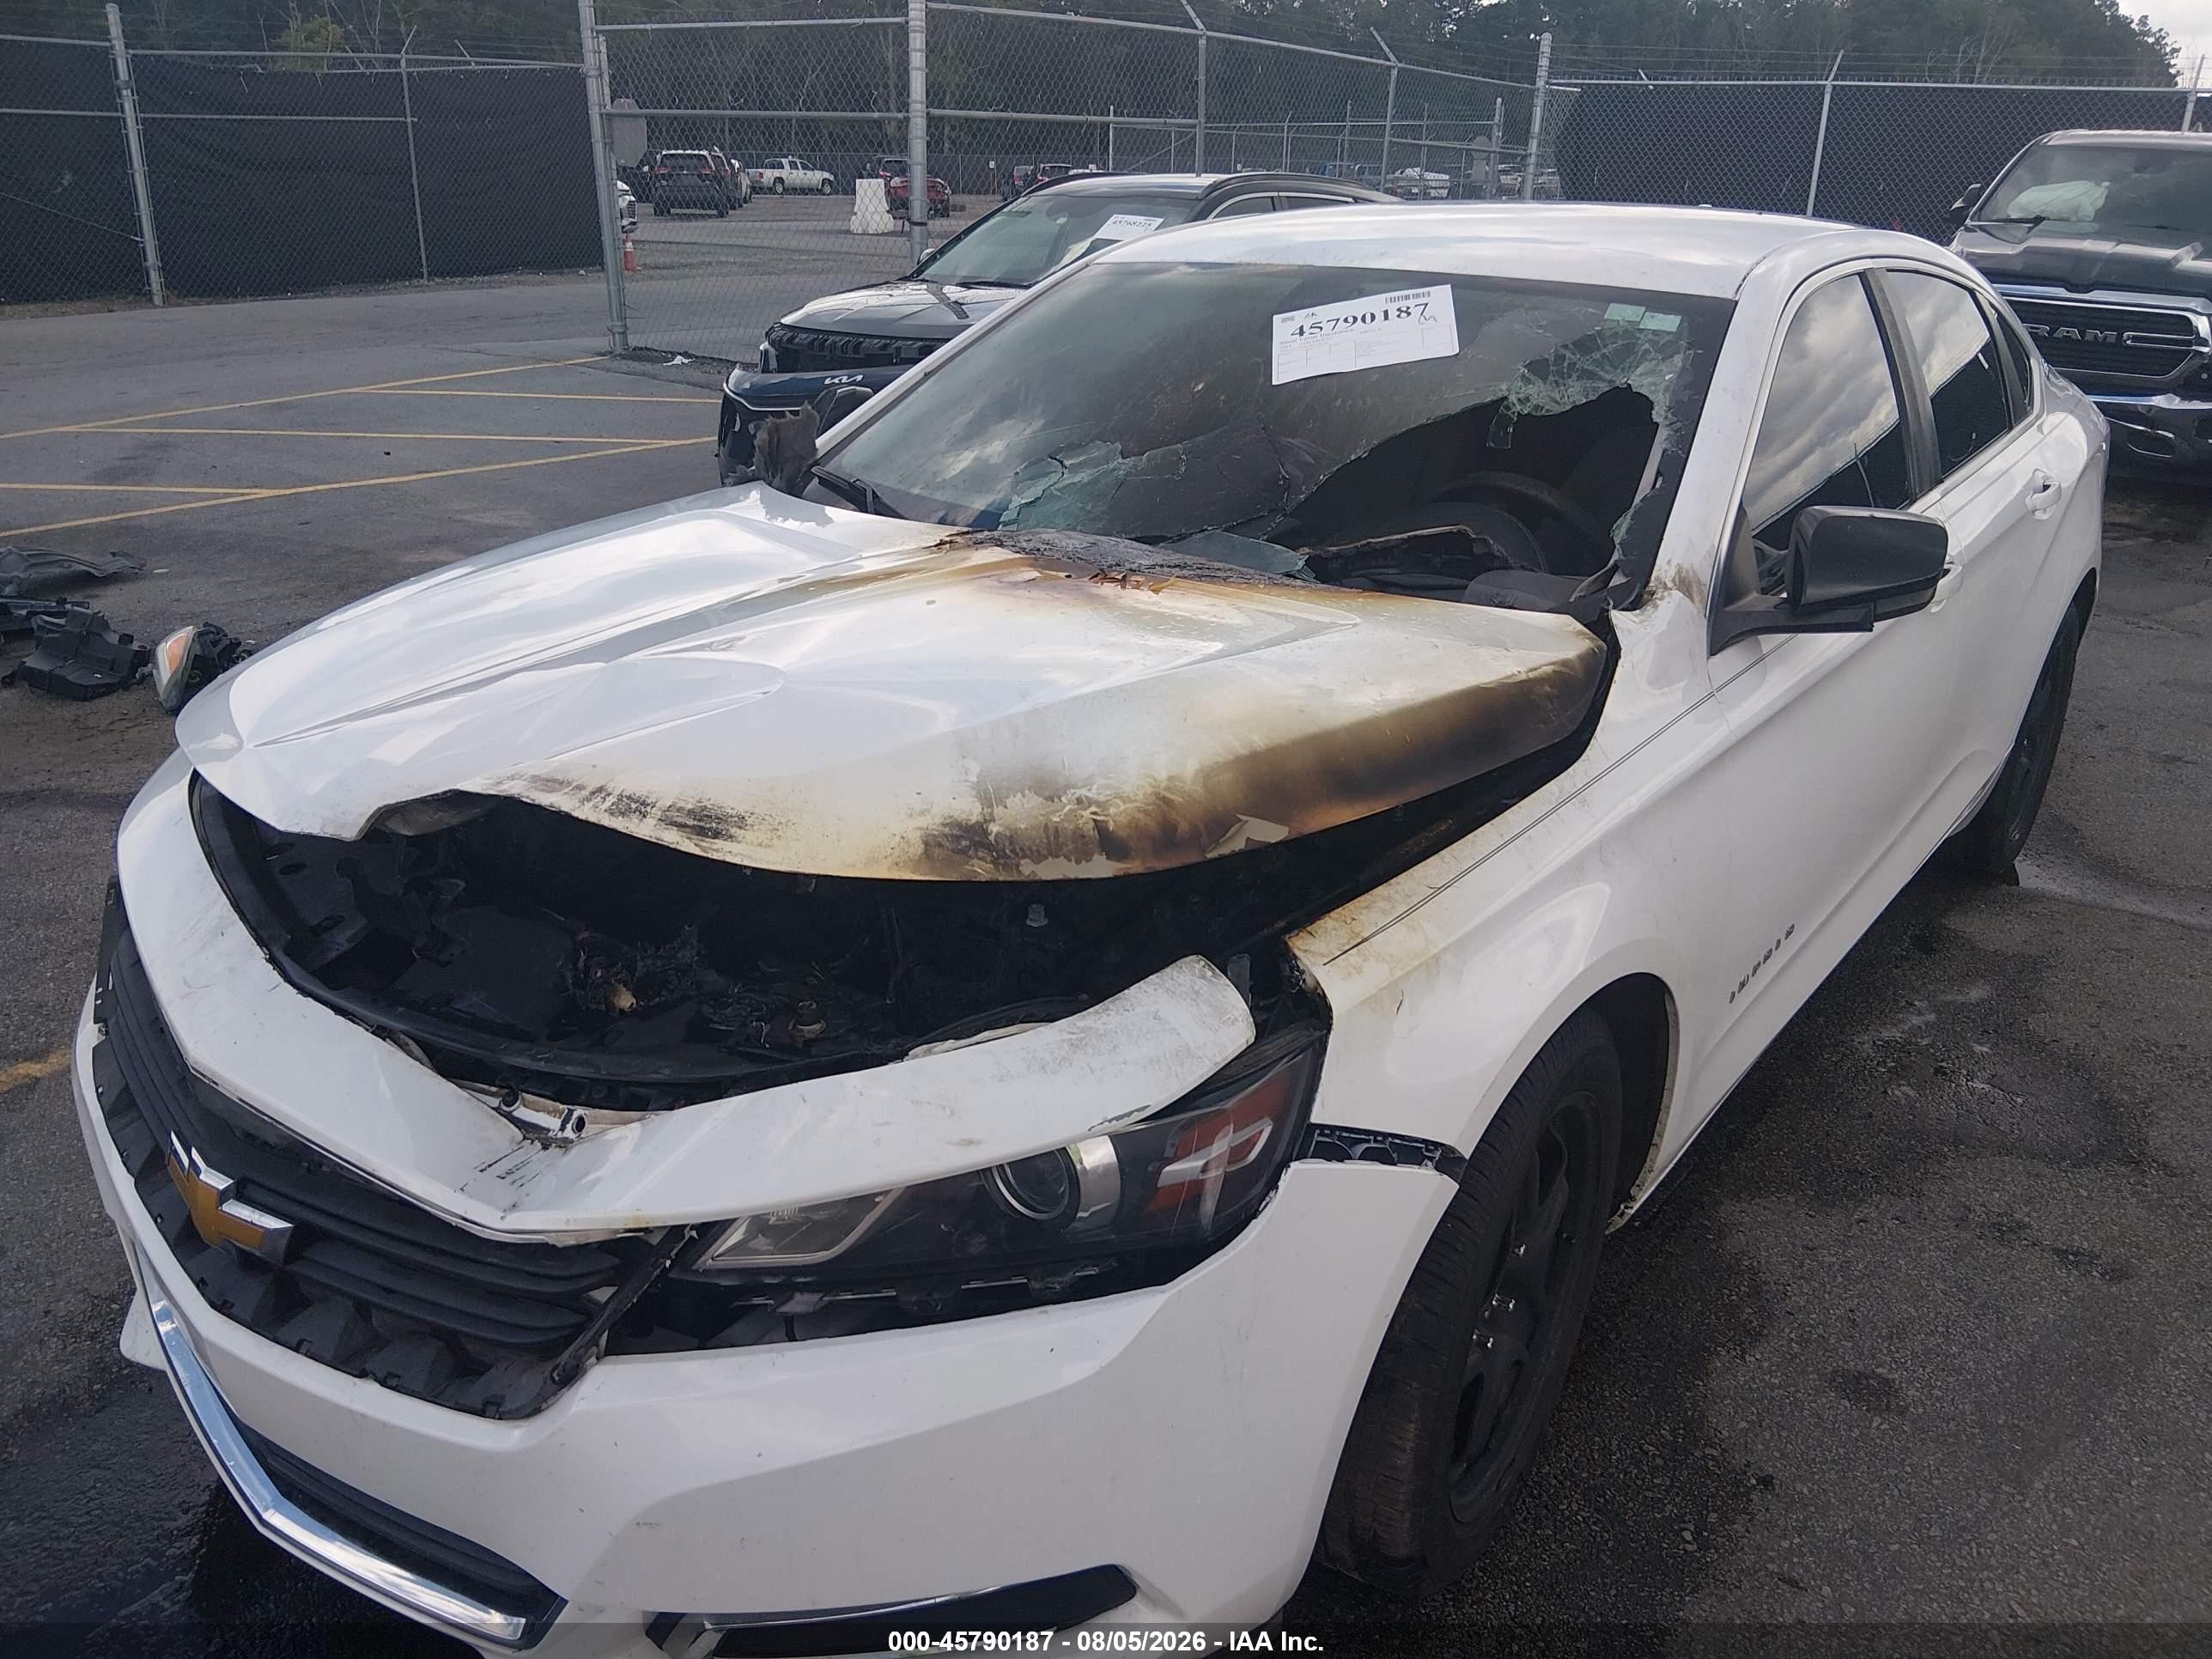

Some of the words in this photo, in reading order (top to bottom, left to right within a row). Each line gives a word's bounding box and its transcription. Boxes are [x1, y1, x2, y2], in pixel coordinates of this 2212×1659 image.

[1291, 302, 1430, 337] 45790187
[2021, 323, 2118, 343] RAM
[824, 374, 864, 385] KIA
